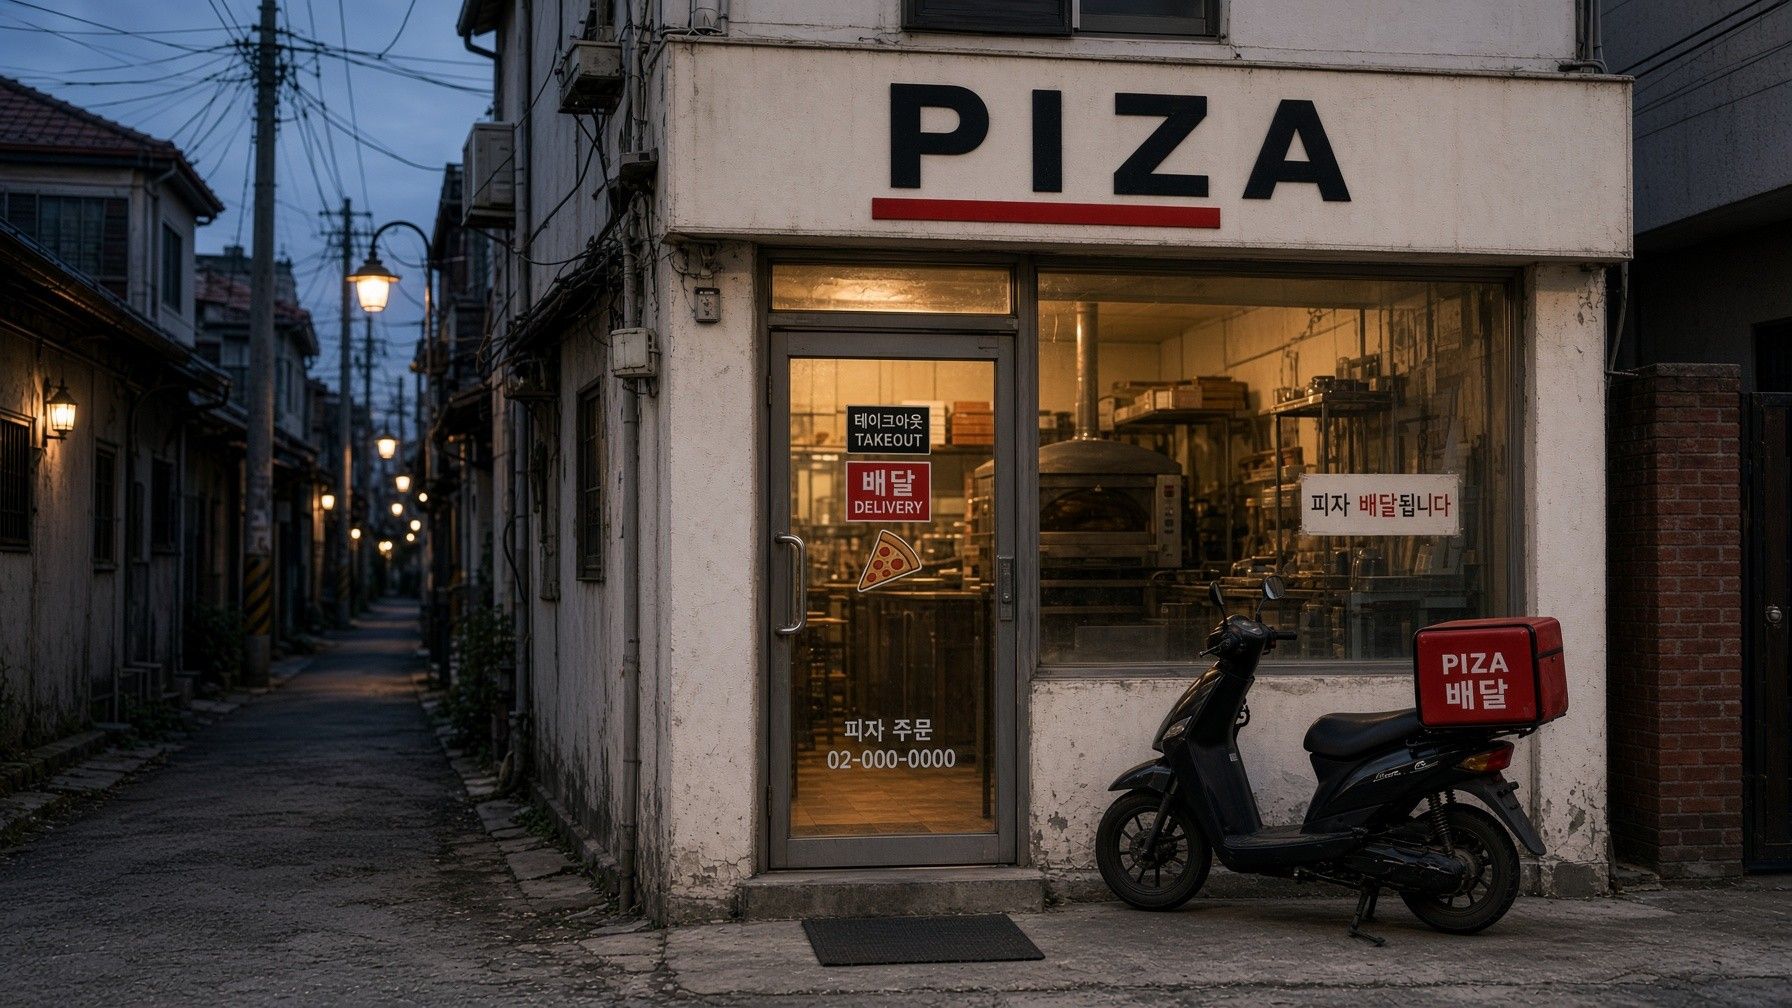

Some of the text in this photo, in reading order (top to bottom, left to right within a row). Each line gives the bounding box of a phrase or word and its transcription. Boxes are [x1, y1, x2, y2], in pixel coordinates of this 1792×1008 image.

[890, 82, 1352, 202] PIZA
[854, 412, 924, 430] 테이크아웃
[854, 433, 923, 447] TAKEOUT
[862, 469, 916, 497] 배달
[854, 500, 923, 514] DELIVERY
[1311, 492, 1452, 518] 피자 배달됩니다
[1441, 651, 1509, 676] PIZA
[1445, 678, 1509, 710] 배달
[844, 718, 933, 743] 피자 주문
[827, 748, 956, 770] 02-000-0000
